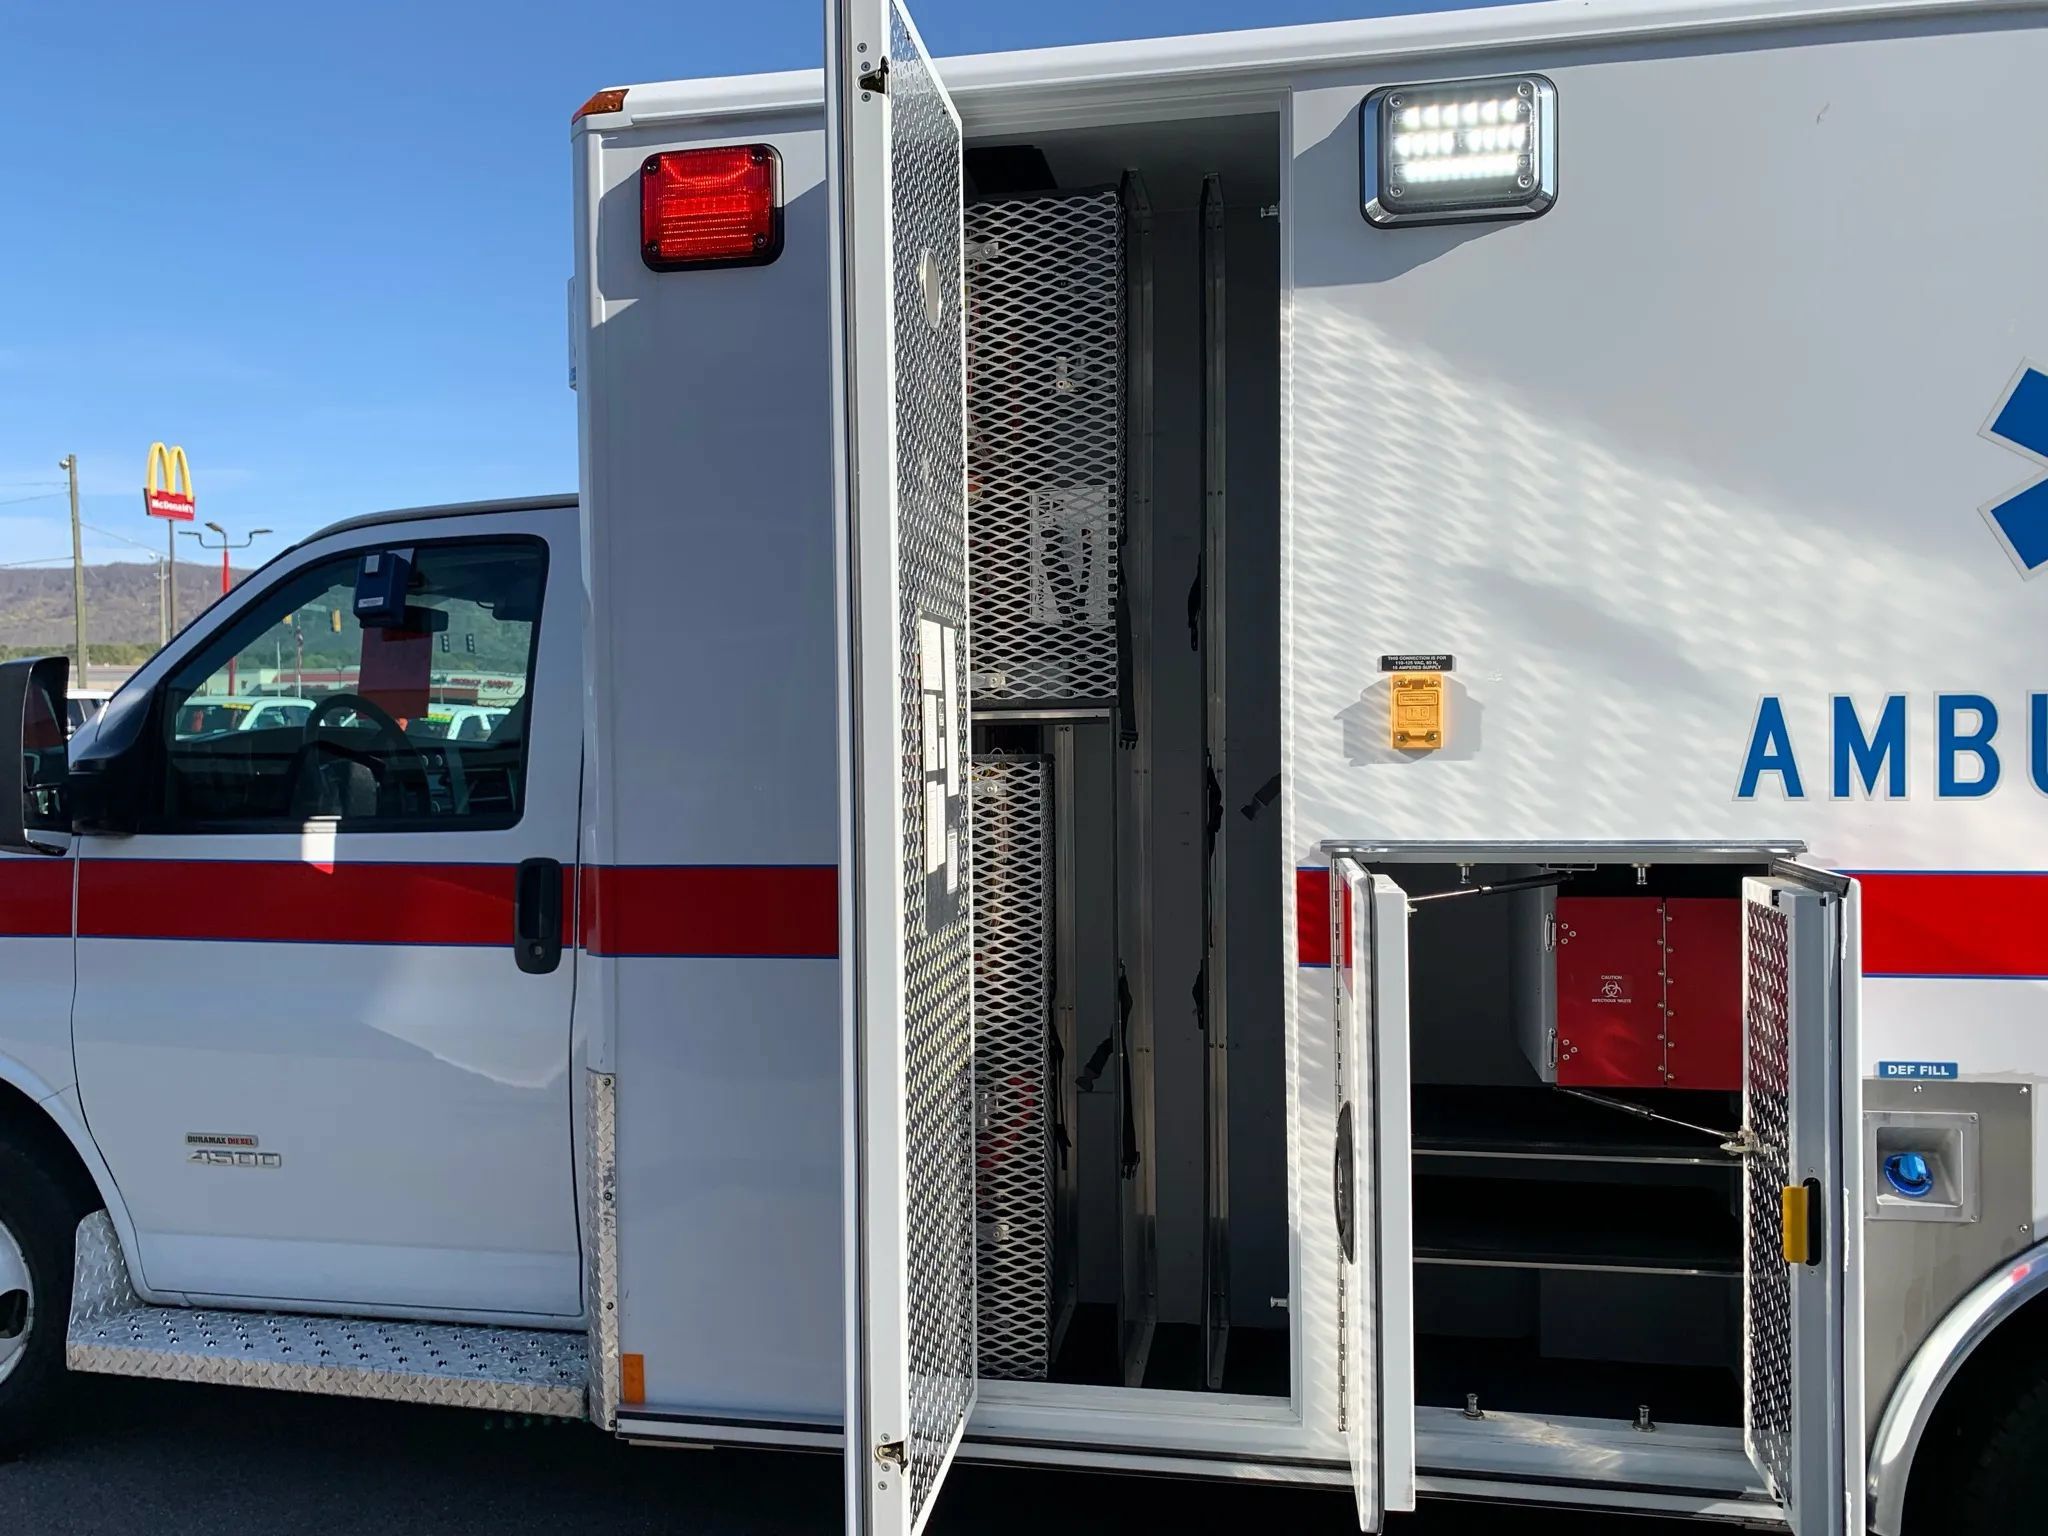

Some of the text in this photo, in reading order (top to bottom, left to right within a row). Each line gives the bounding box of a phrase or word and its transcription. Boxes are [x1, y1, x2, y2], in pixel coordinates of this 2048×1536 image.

[1735, 692, 2048, 798] AMB
[1887, 1065, 1949, 1076] DEF FILL
[187, 1135, 255, 1146] DURAMAX DIESEL
[187, 1149, 282, 1168] 4500
